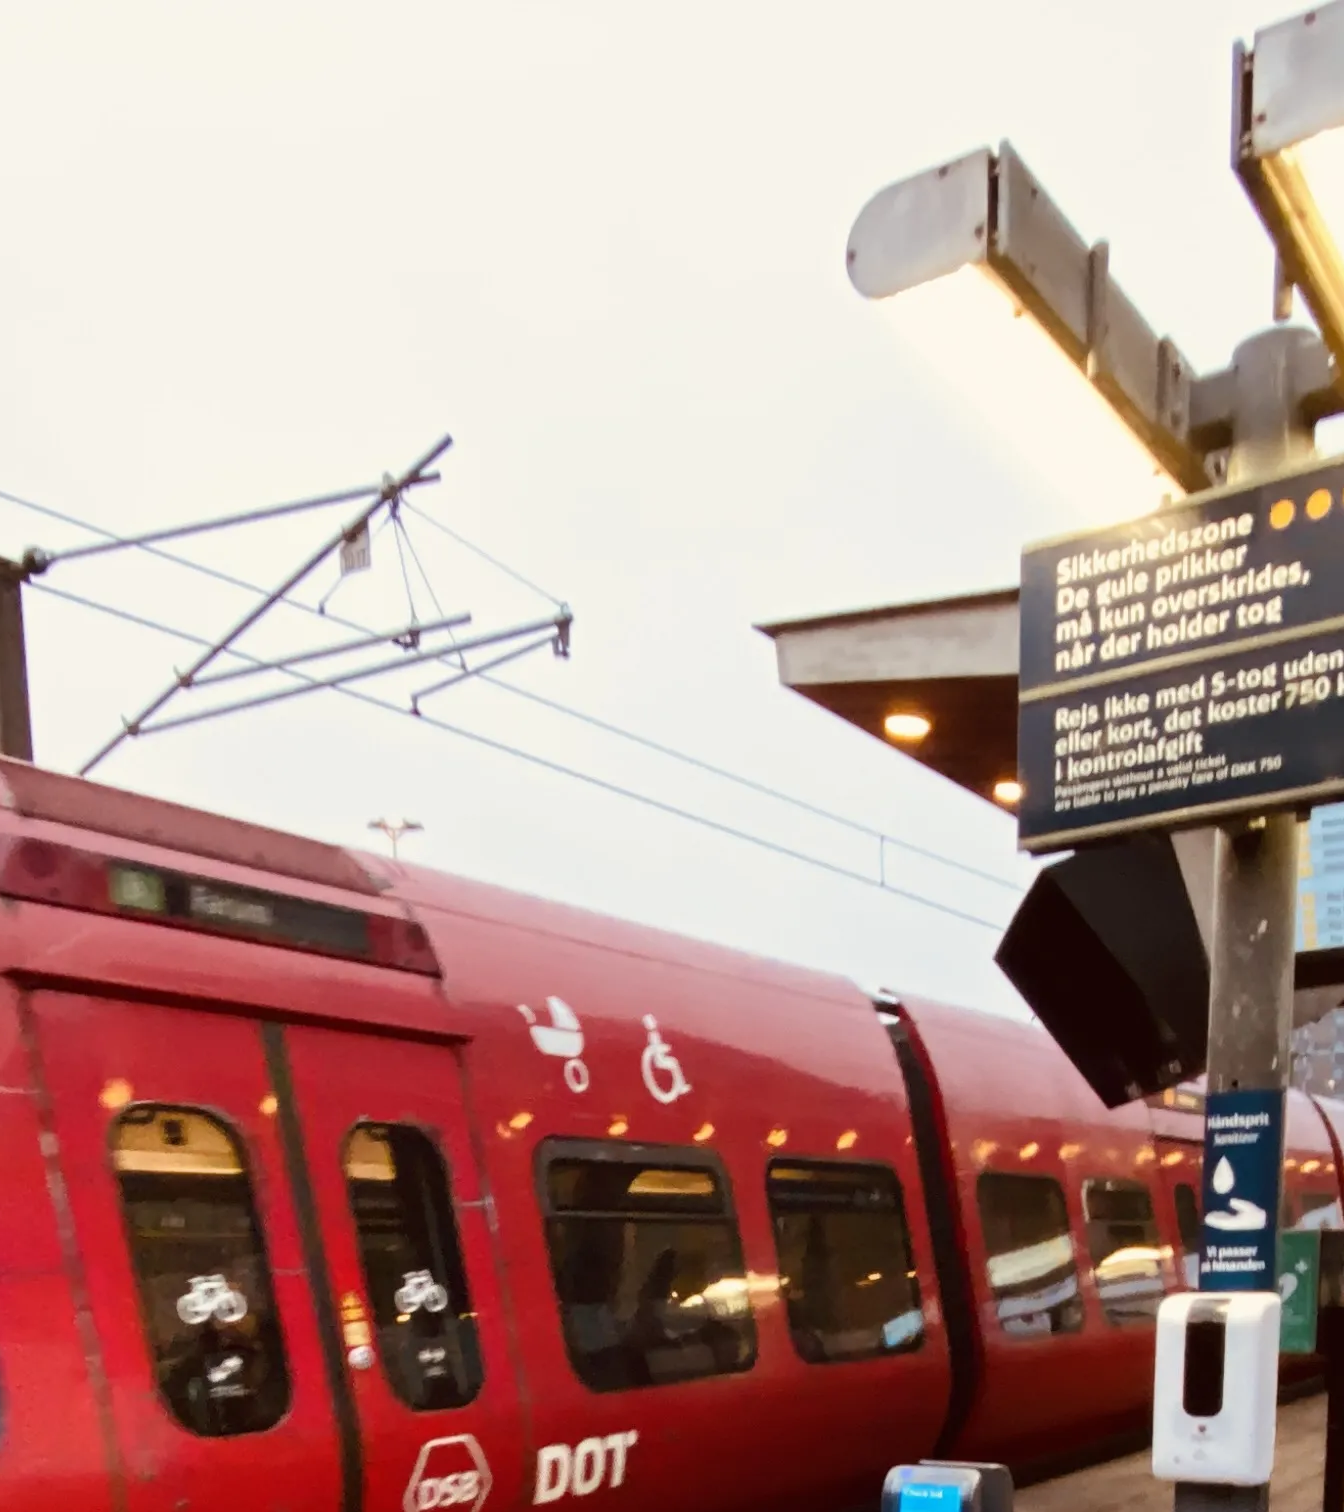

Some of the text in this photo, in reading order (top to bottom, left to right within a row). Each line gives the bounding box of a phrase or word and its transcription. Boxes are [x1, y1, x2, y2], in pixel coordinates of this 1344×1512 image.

[1057, 513, 1253, 584] Sikkerhedszone
[1057, 544, 1248, 614] De gule prikker
[1056, 561, 1310, 643] må kun overskrides,
[1056, 595, 1283, 672] når der holder tog
[1055, 703, 1098, 733] Rejs
[1105, 691, 1149, 720] ikke
[1156, 675, 1205, 708] med
[1211, 662, 1277, 697] S-tog
[1284, 649, 1344, 680] uden
[1055, 730, 1102, 757] eller
[1108, 715, 1156, 745] kort,
[1165, 706, 1201, 733] det
[1208, 689, 1281, 724] koster
[1284, 678, 1331, 710] 750
[1068, 732, 1204, 779] kontrolafgift
[1260, 754, 1282, 773] 750
[1219, 1246, 1258, 1260] passer
[418, 1470, 480, 1511] DSB
[532, 1429, 639, 1505] DOT
